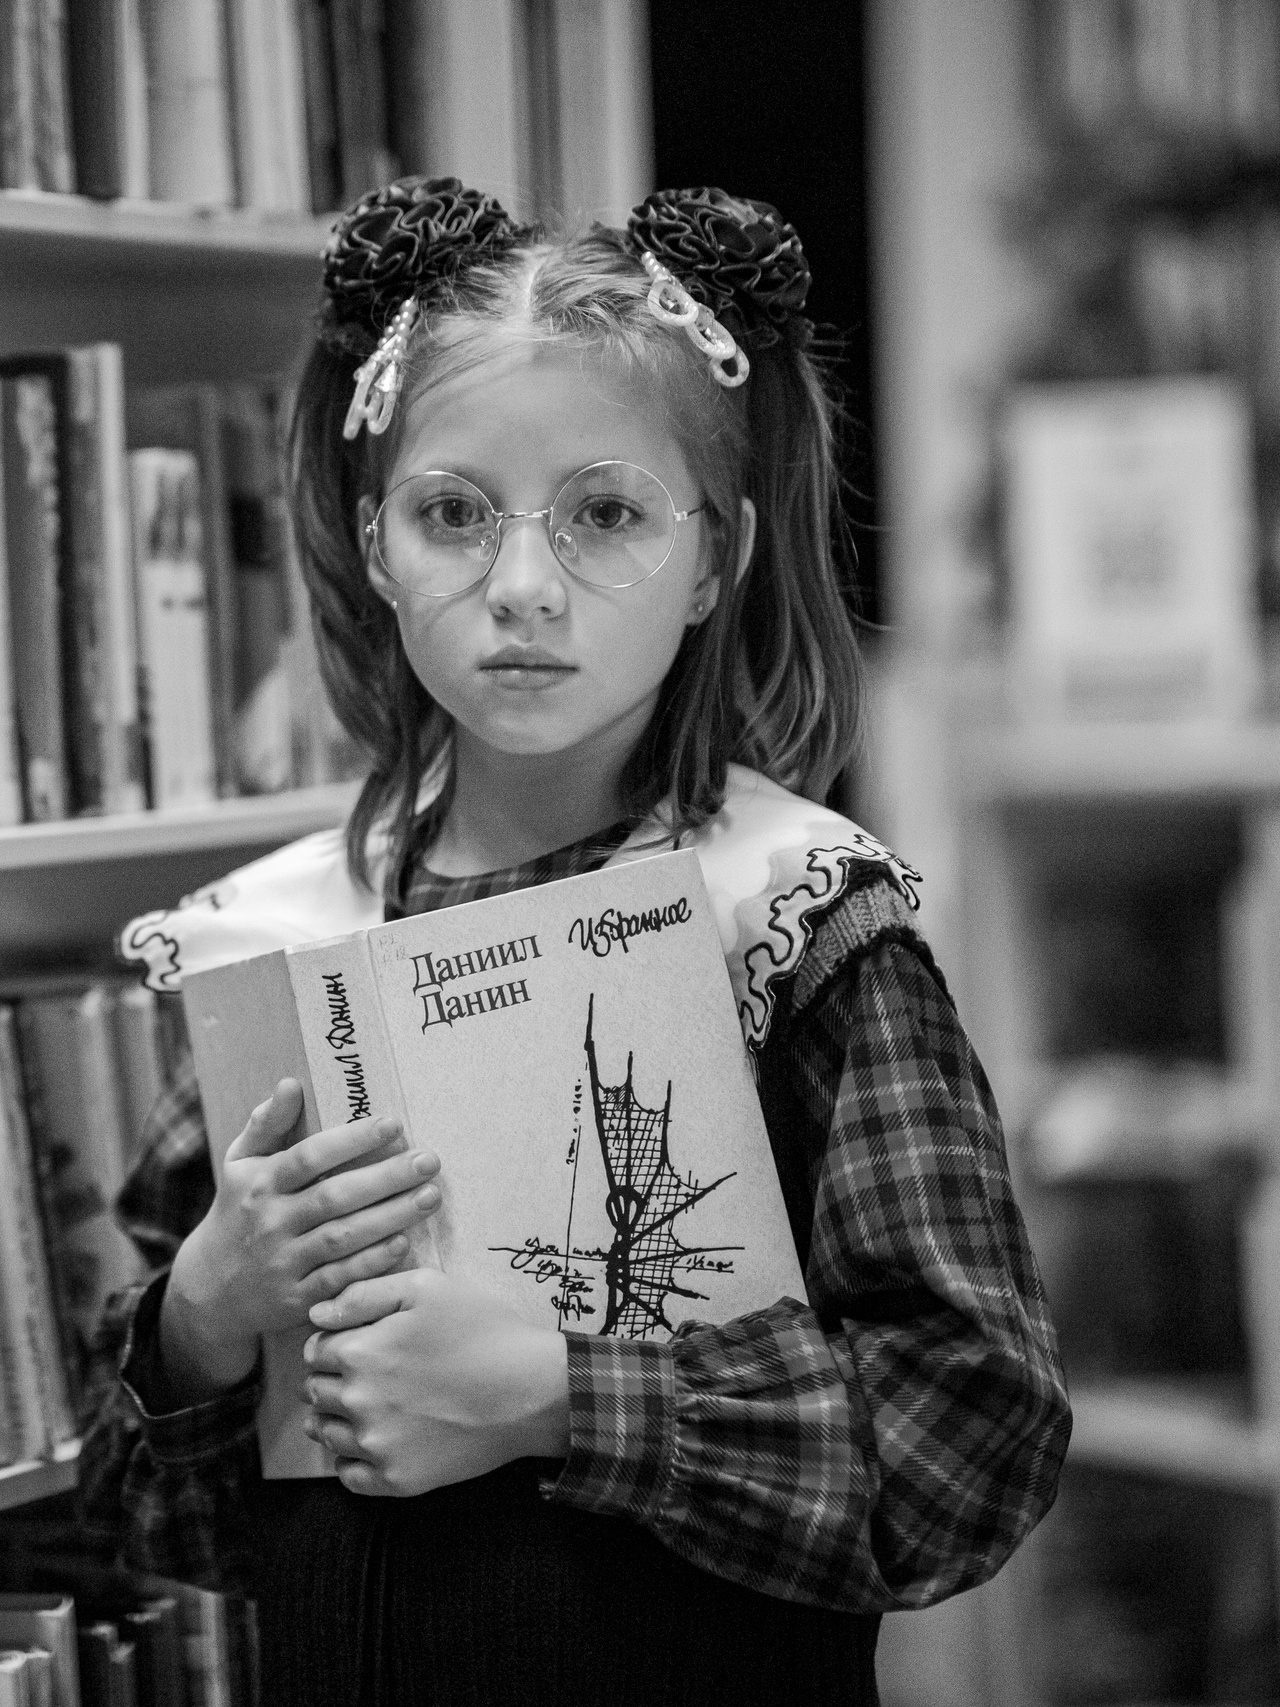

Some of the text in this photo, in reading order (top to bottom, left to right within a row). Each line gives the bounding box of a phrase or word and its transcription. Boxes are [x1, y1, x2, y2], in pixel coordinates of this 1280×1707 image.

[567, 896, 693, 958] Избранное
[409, 935, 543, 997] Даниил
[321, 972, 357, 1050] Данин
[420, 978, 532, 1036] Данин
